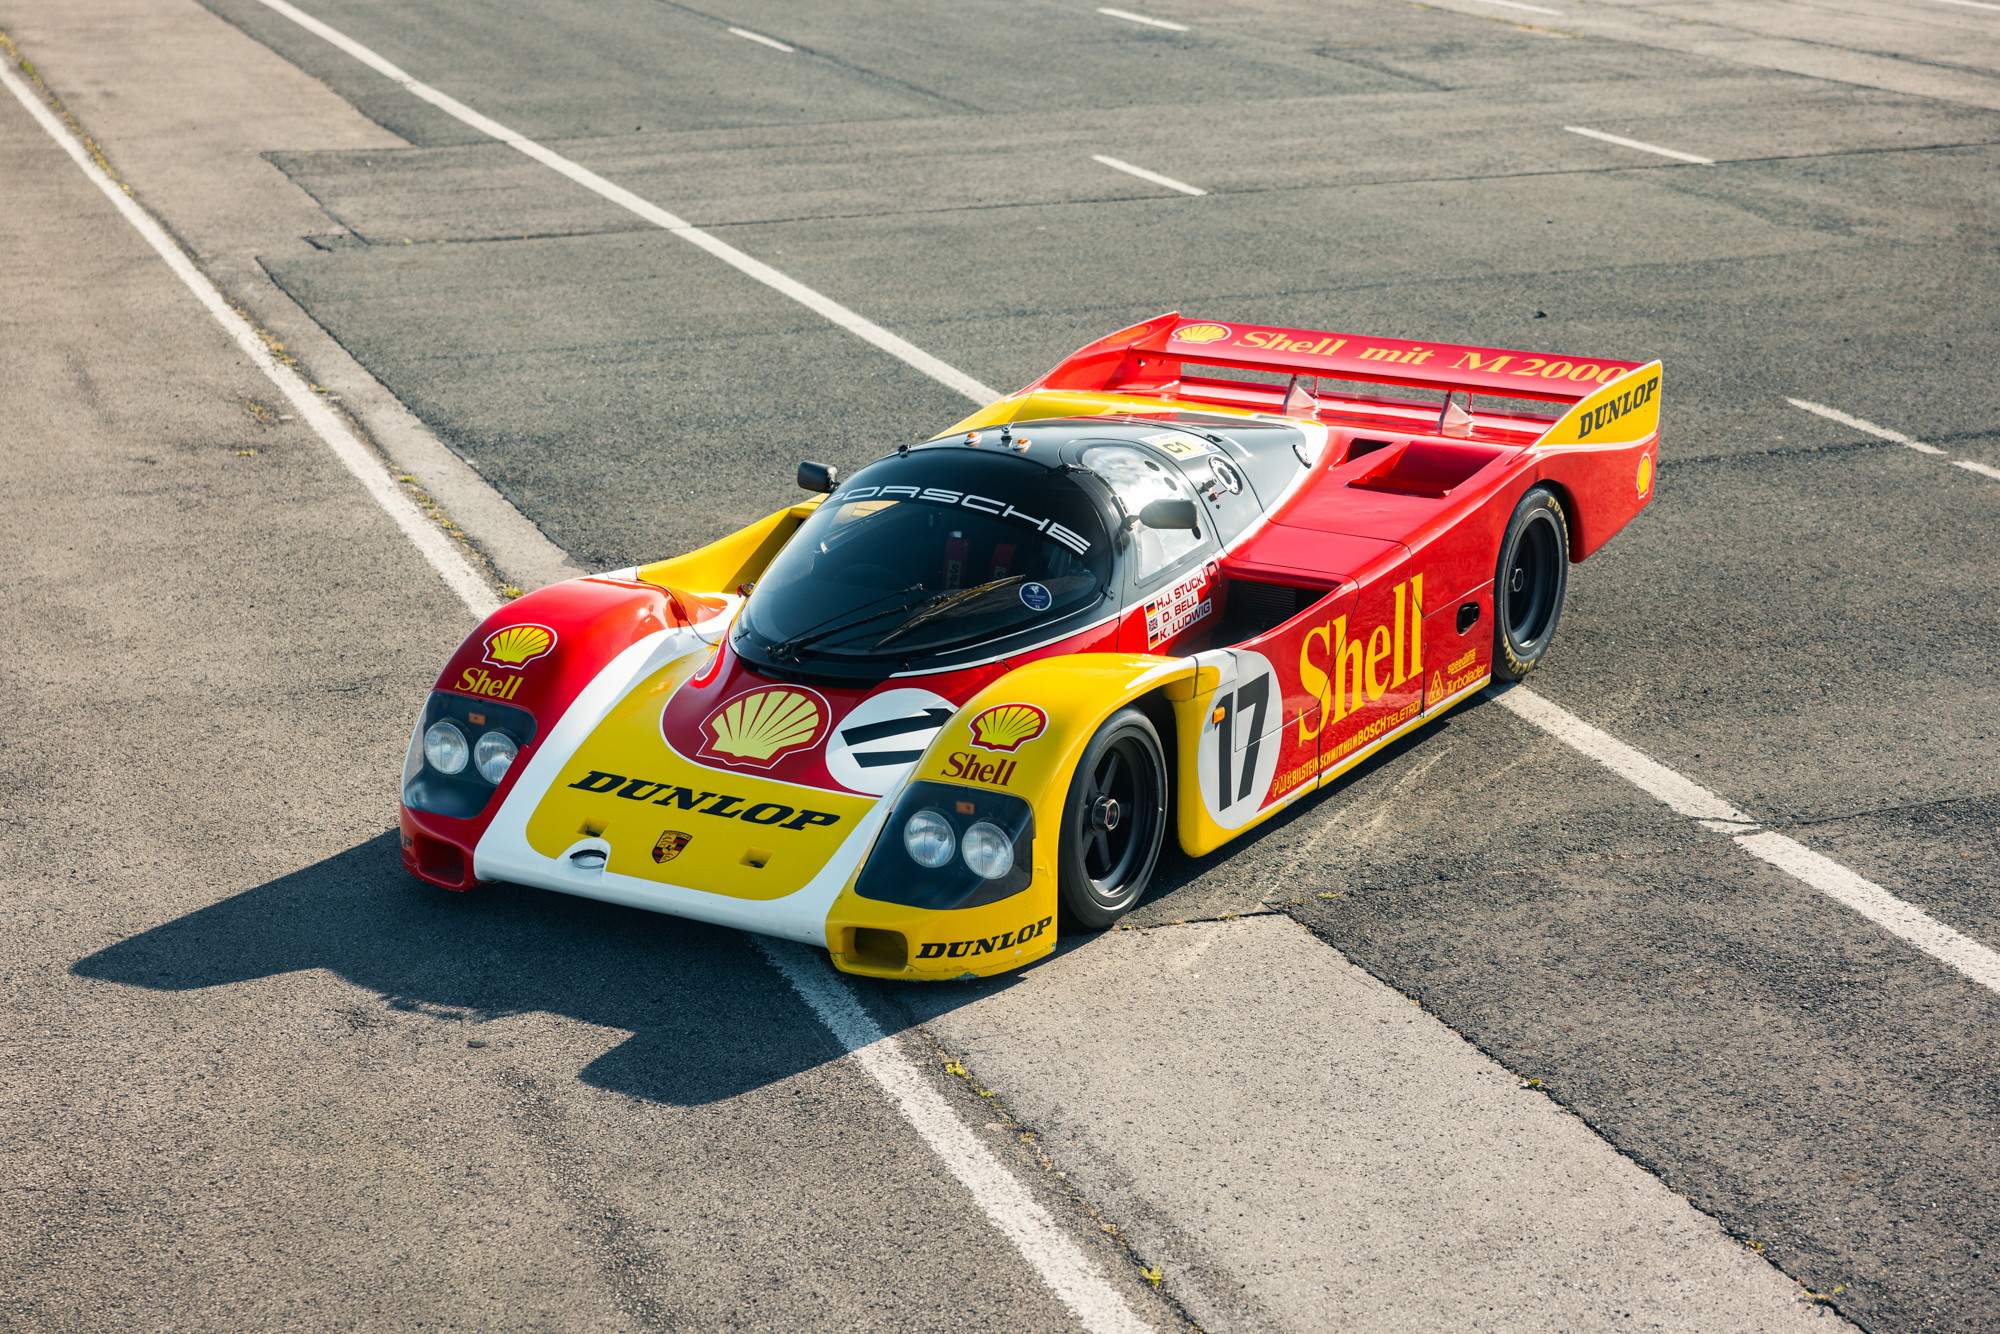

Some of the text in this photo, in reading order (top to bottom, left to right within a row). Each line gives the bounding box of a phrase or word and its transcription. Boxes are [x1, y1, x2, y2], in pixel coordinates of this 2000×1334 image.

[1232, 331, 1347, 356] Shell
[1355, 346, 1435, 365] mit
[1578, 376, 1658, 439] DUNLOP
[819, 485, 1091, 556] PORSCHE
[1173, 573, 1204, 600] STUCK
[1160, 601, 1211, 641] K. LUDWIG
[1162, 596, 1197, 623] D. BELL
[1299, 572, 1424, 748] Shell
[1447, 663, 1487, 695] Turbolader
[454, 667, 524, 700] Shell
[1214, 671, 1270, 812] 17
[1292, 755, 1318, 786] BILSTEIN
[1358, 715, 1386, 746] BOSCH
[941, 751, 1017, 787] Shell
[567, 770, 841, 831] DUNLOP
[915, 915, 1053, 959] DUNLOP
